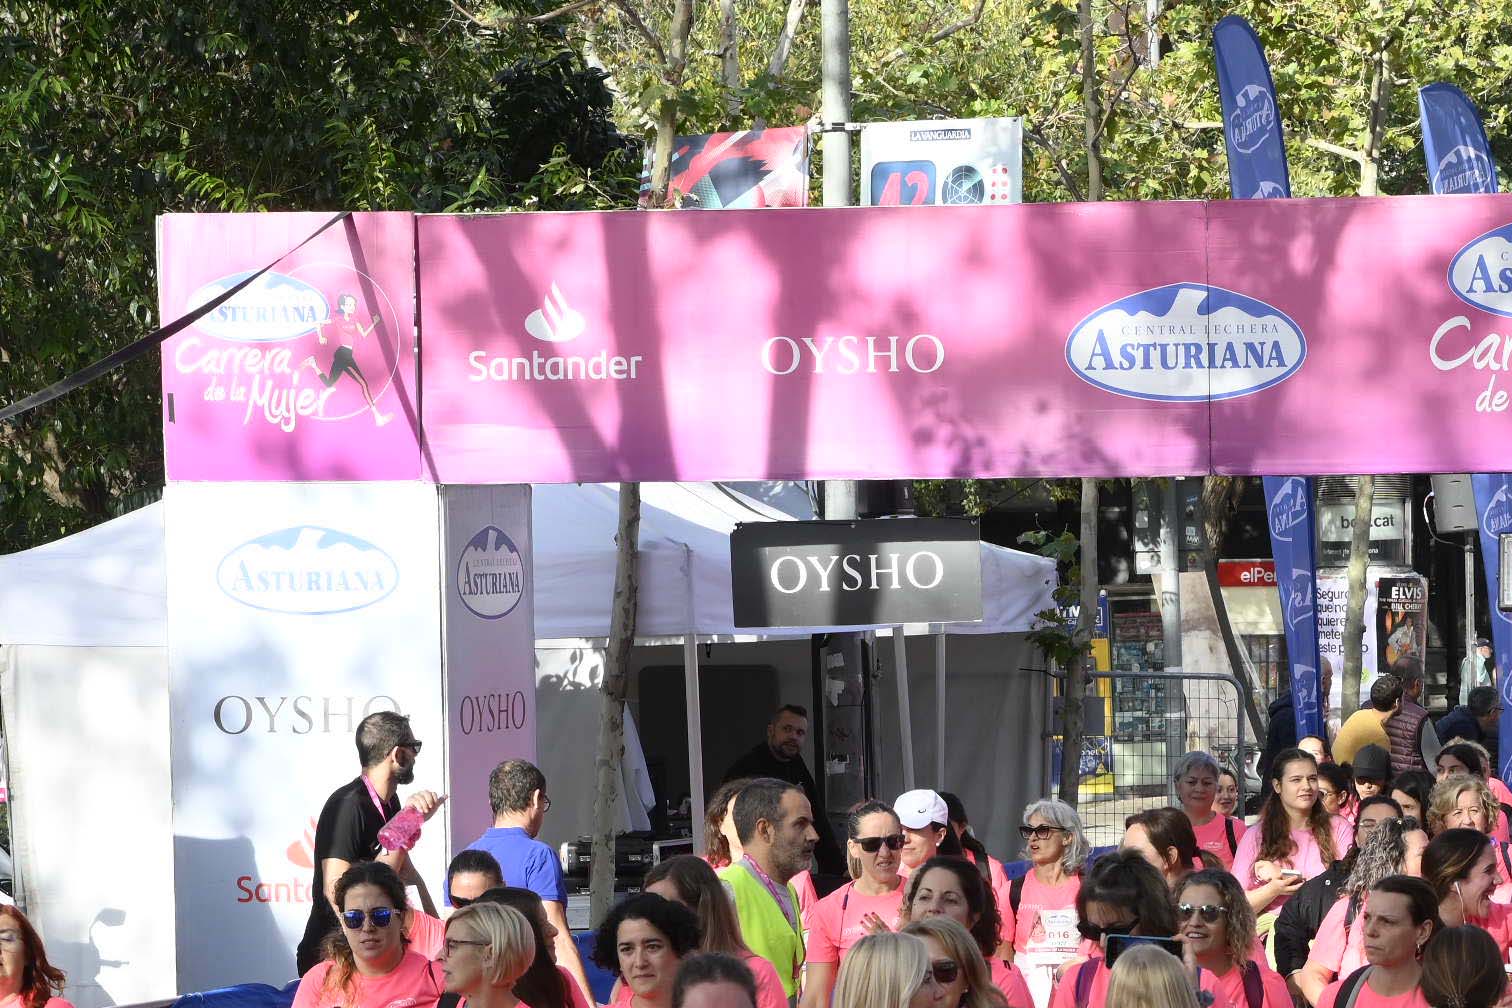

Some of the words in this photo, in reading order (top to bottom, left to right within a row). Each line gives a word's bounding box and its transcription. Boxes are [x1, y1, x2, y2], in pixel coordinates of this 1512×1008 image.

[911, 130, 921, 140] LA
[920, 129, 970, 140] VANGUARDIA
[879, 170, 929, 206] 42
[1121, 321, 1197, 335] CENTRAL
[1203, 321, 1280, 335] LECHERA
[175, 336, 292, 375] Carrera
[468, 347, 642, 380] Santander
[761, 333, 945, 376] OYSHO
[1084, 333, 1288, 373] ASTURIANA
[203, 383, 226, 401] de
[230, 379, 247, 401] la
[243, 371, 337, 433] Mujer
[1475, 374, 1510, 413] de
[231, 559, 386, 592] ASTURIANA
[462, 561, 520, 596] ASTURIANA
[770, 550, 945, 594] OYSHO
[1391, 587, 1422, 599] ELVIS
[460, 690, 527, 736] OYSHO
